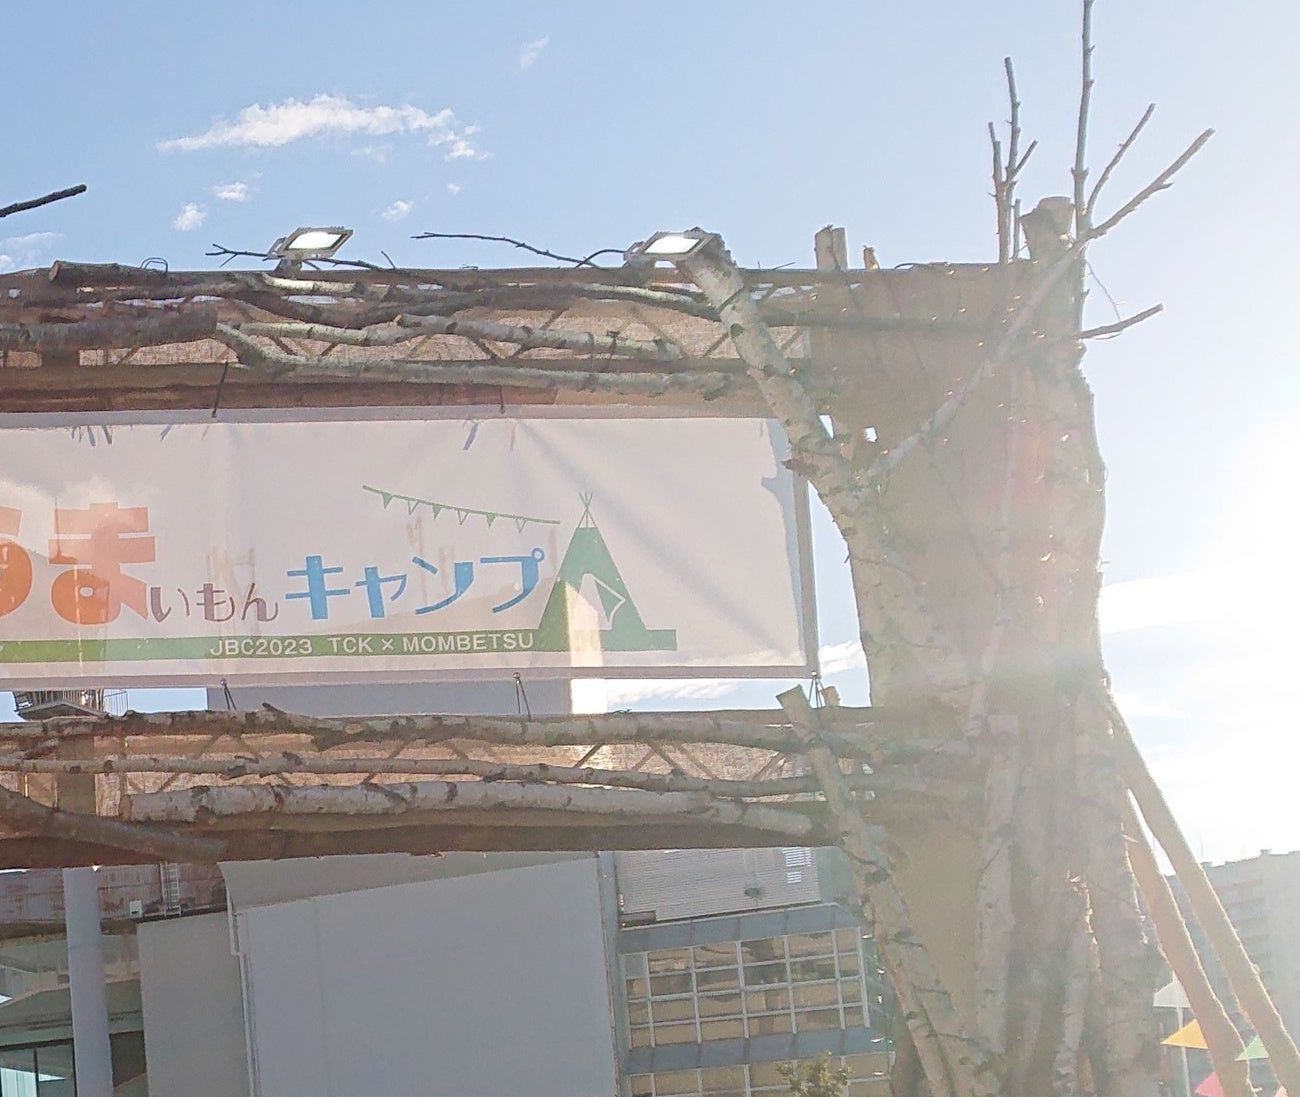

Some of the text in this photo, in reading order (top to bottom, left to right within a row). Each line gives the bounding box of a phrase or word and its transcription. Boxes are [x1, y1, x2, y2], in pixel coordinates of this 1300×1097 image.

[285, 547, 546, 620] キャンプ
[209, 637, 314, 656] JBC2023
[327, 635, 374, 654] TCK
[402, 632, 535, 653] MOMBETSU
